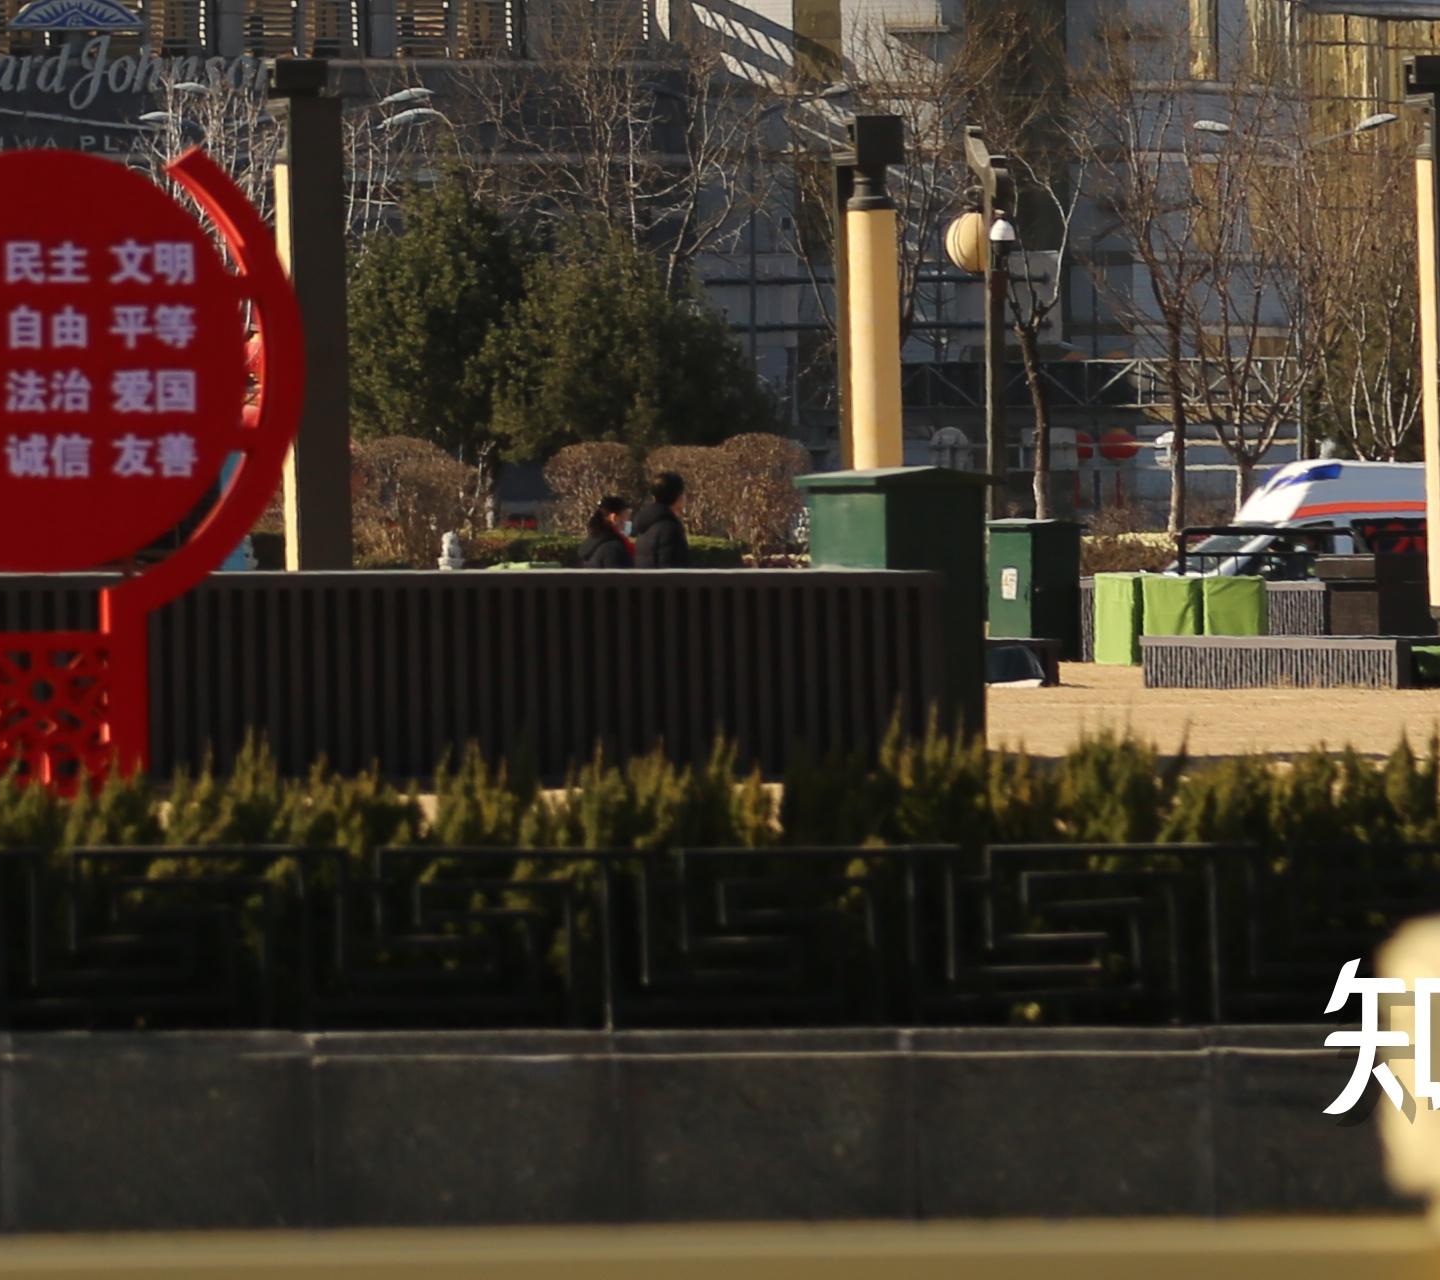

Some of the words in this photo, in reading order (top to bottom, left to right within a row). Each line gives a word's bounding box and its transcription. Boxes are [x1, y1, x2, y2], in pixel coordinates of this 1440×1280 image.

[6, 240, 91, 284] 民主
[109, 239, 196, 285] 文明
[9, 305, 89, 349] 自由
[109, 305, 197, 349] 平等
[5, 369, 92, 414] 法治
[111, 369, 197, 414] 爱国
[5, 433, 93, 479] 诚信
[112, 433, 199, 479] 友善
